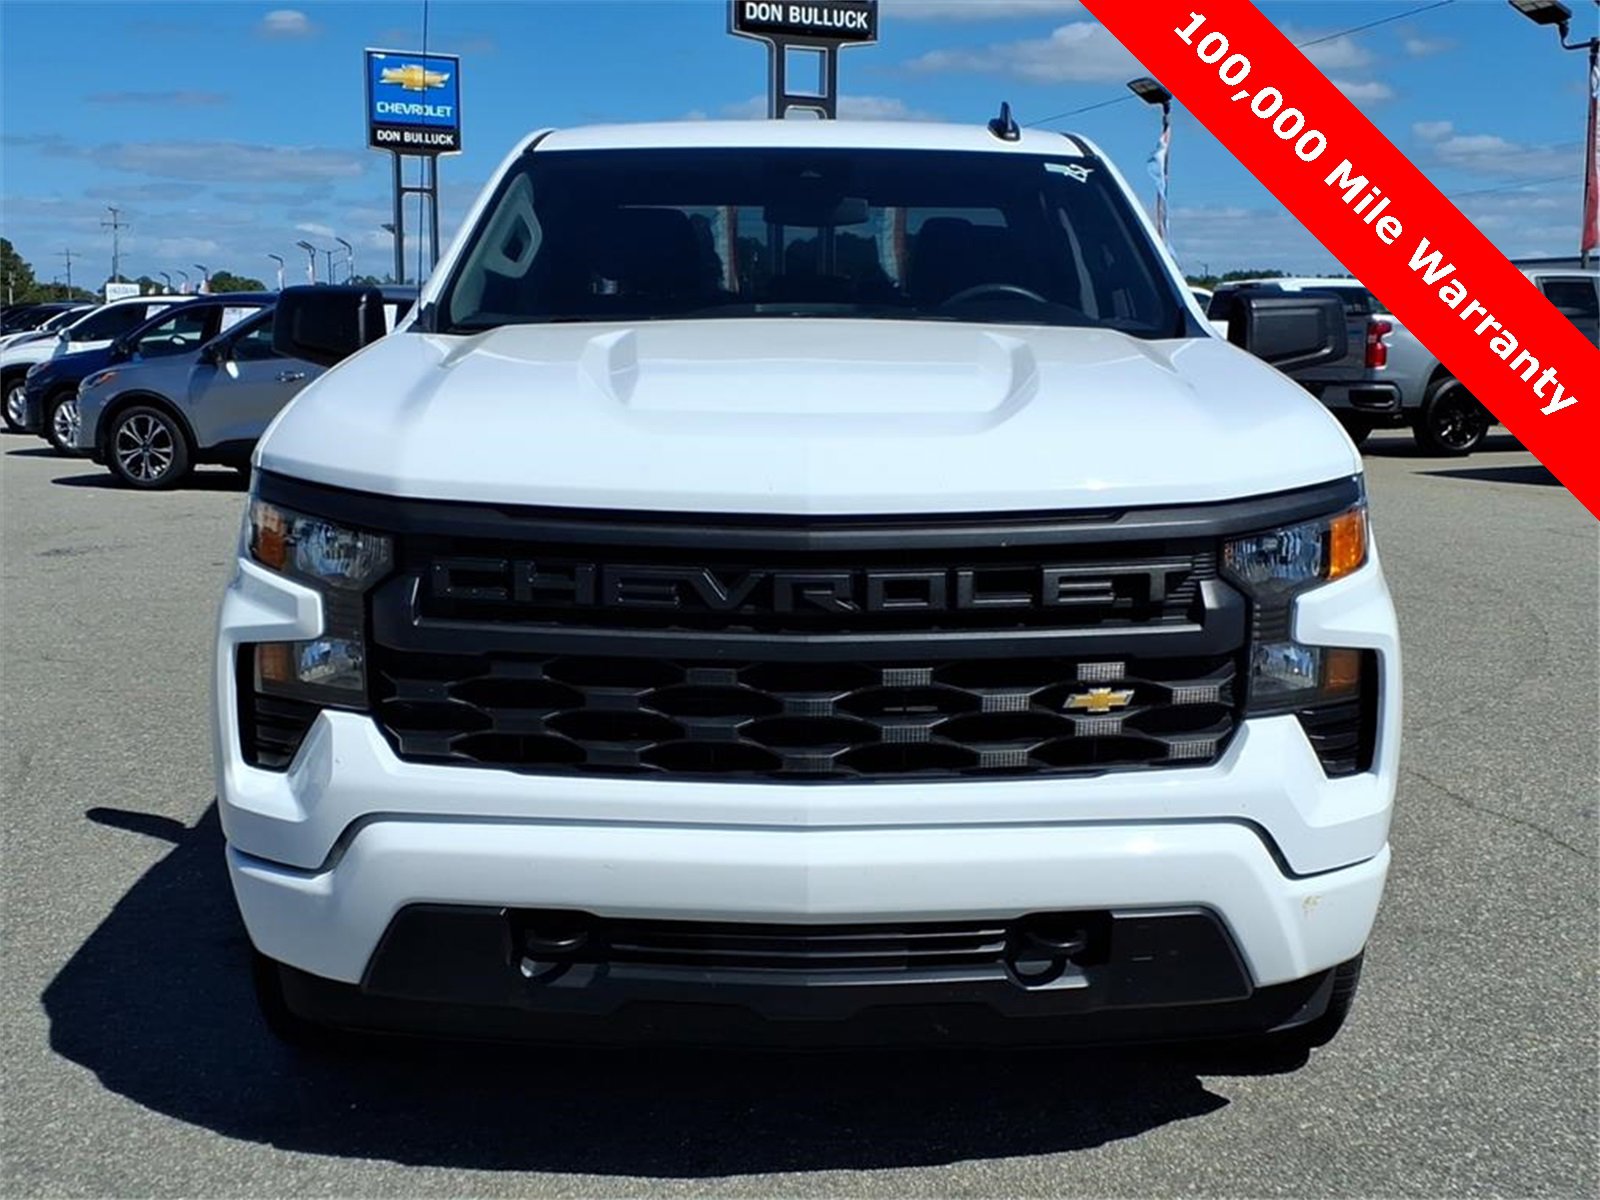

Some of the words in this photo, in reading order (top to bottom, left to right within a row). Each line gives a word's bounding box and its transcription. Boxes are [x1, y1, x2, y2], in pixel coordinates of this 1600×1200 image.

[744, 1, 784, 22] DON
[788, 5, 869, 29] BULLUCK
[376, 100, 453, 118] CHEVROLET
[376, 129, 401, 142] DON
[403, 132, 454, 146] BULLUCK
[430, 556, 1194, 612] CHEVROLET
